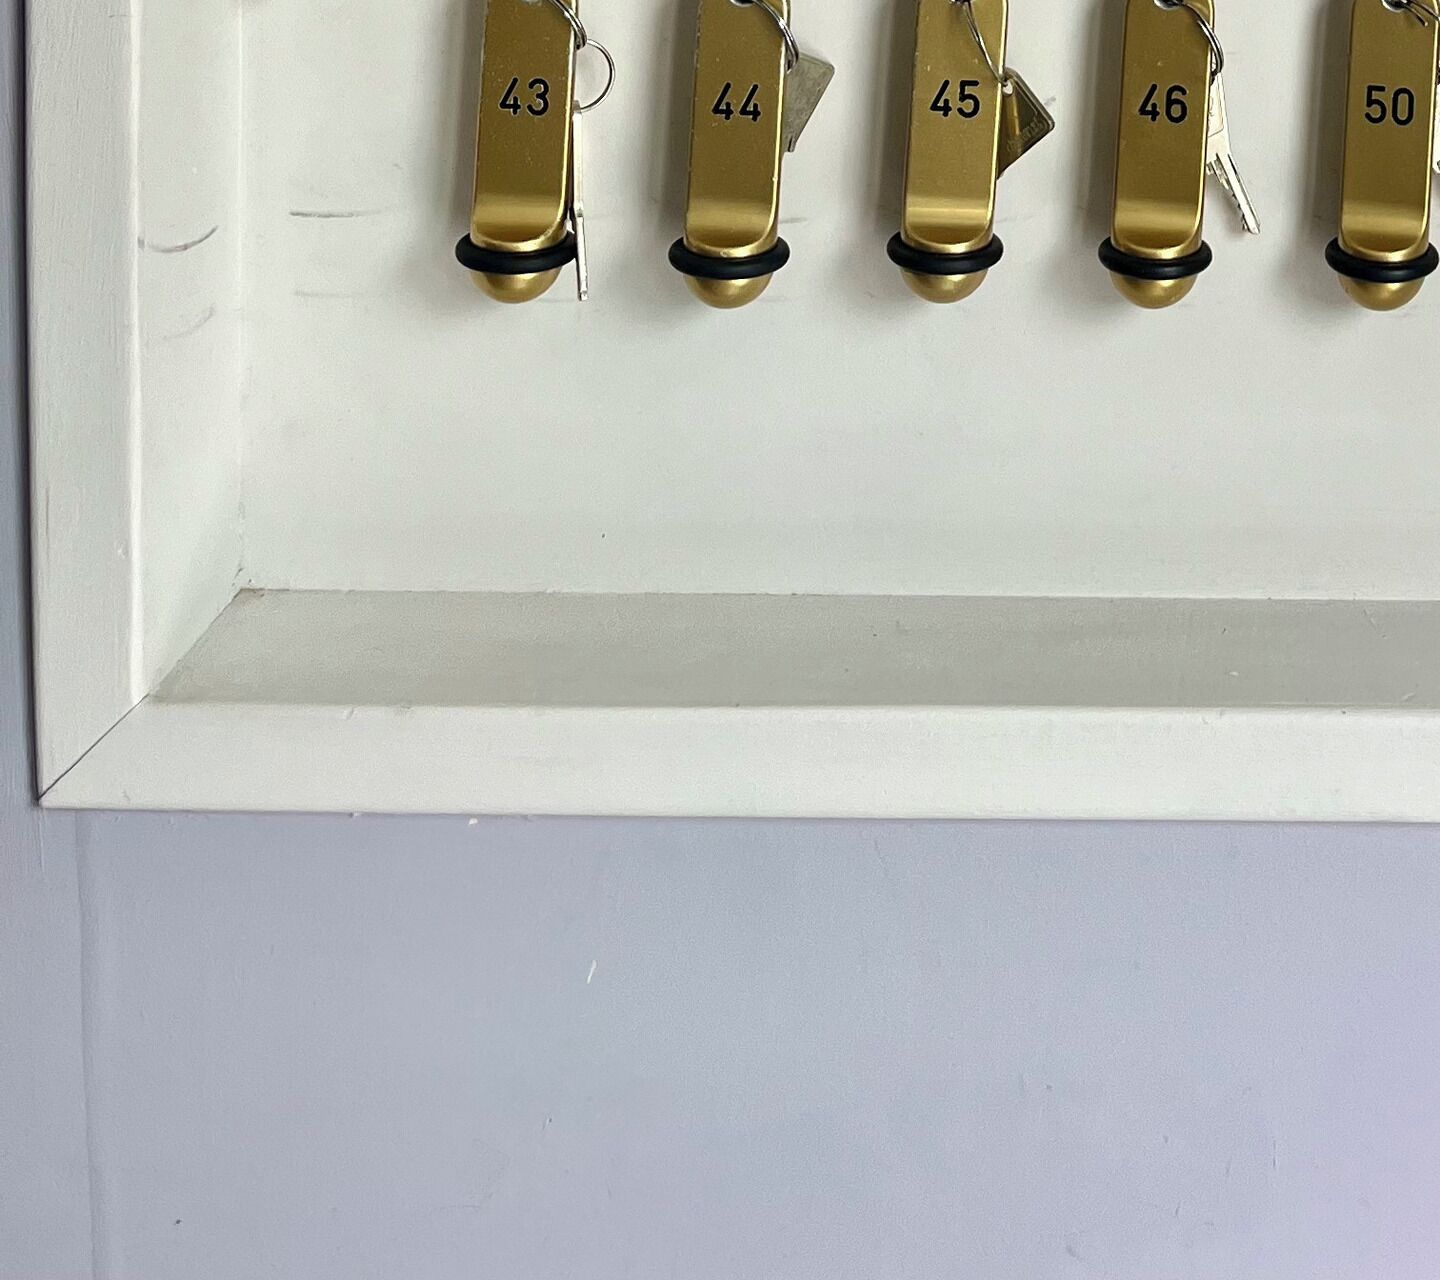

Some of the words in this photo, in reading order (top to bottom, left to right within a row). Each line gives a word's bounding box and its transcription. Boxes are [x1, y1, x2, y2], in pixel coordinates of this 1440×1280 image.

[499, 78, 550, 117] 43
[712, 81, 761, 122] 44
[930, 79, 981, 119] 45
[1138, 84, 1189, 124] 46
[1364, 86, 1415, 126] 50
